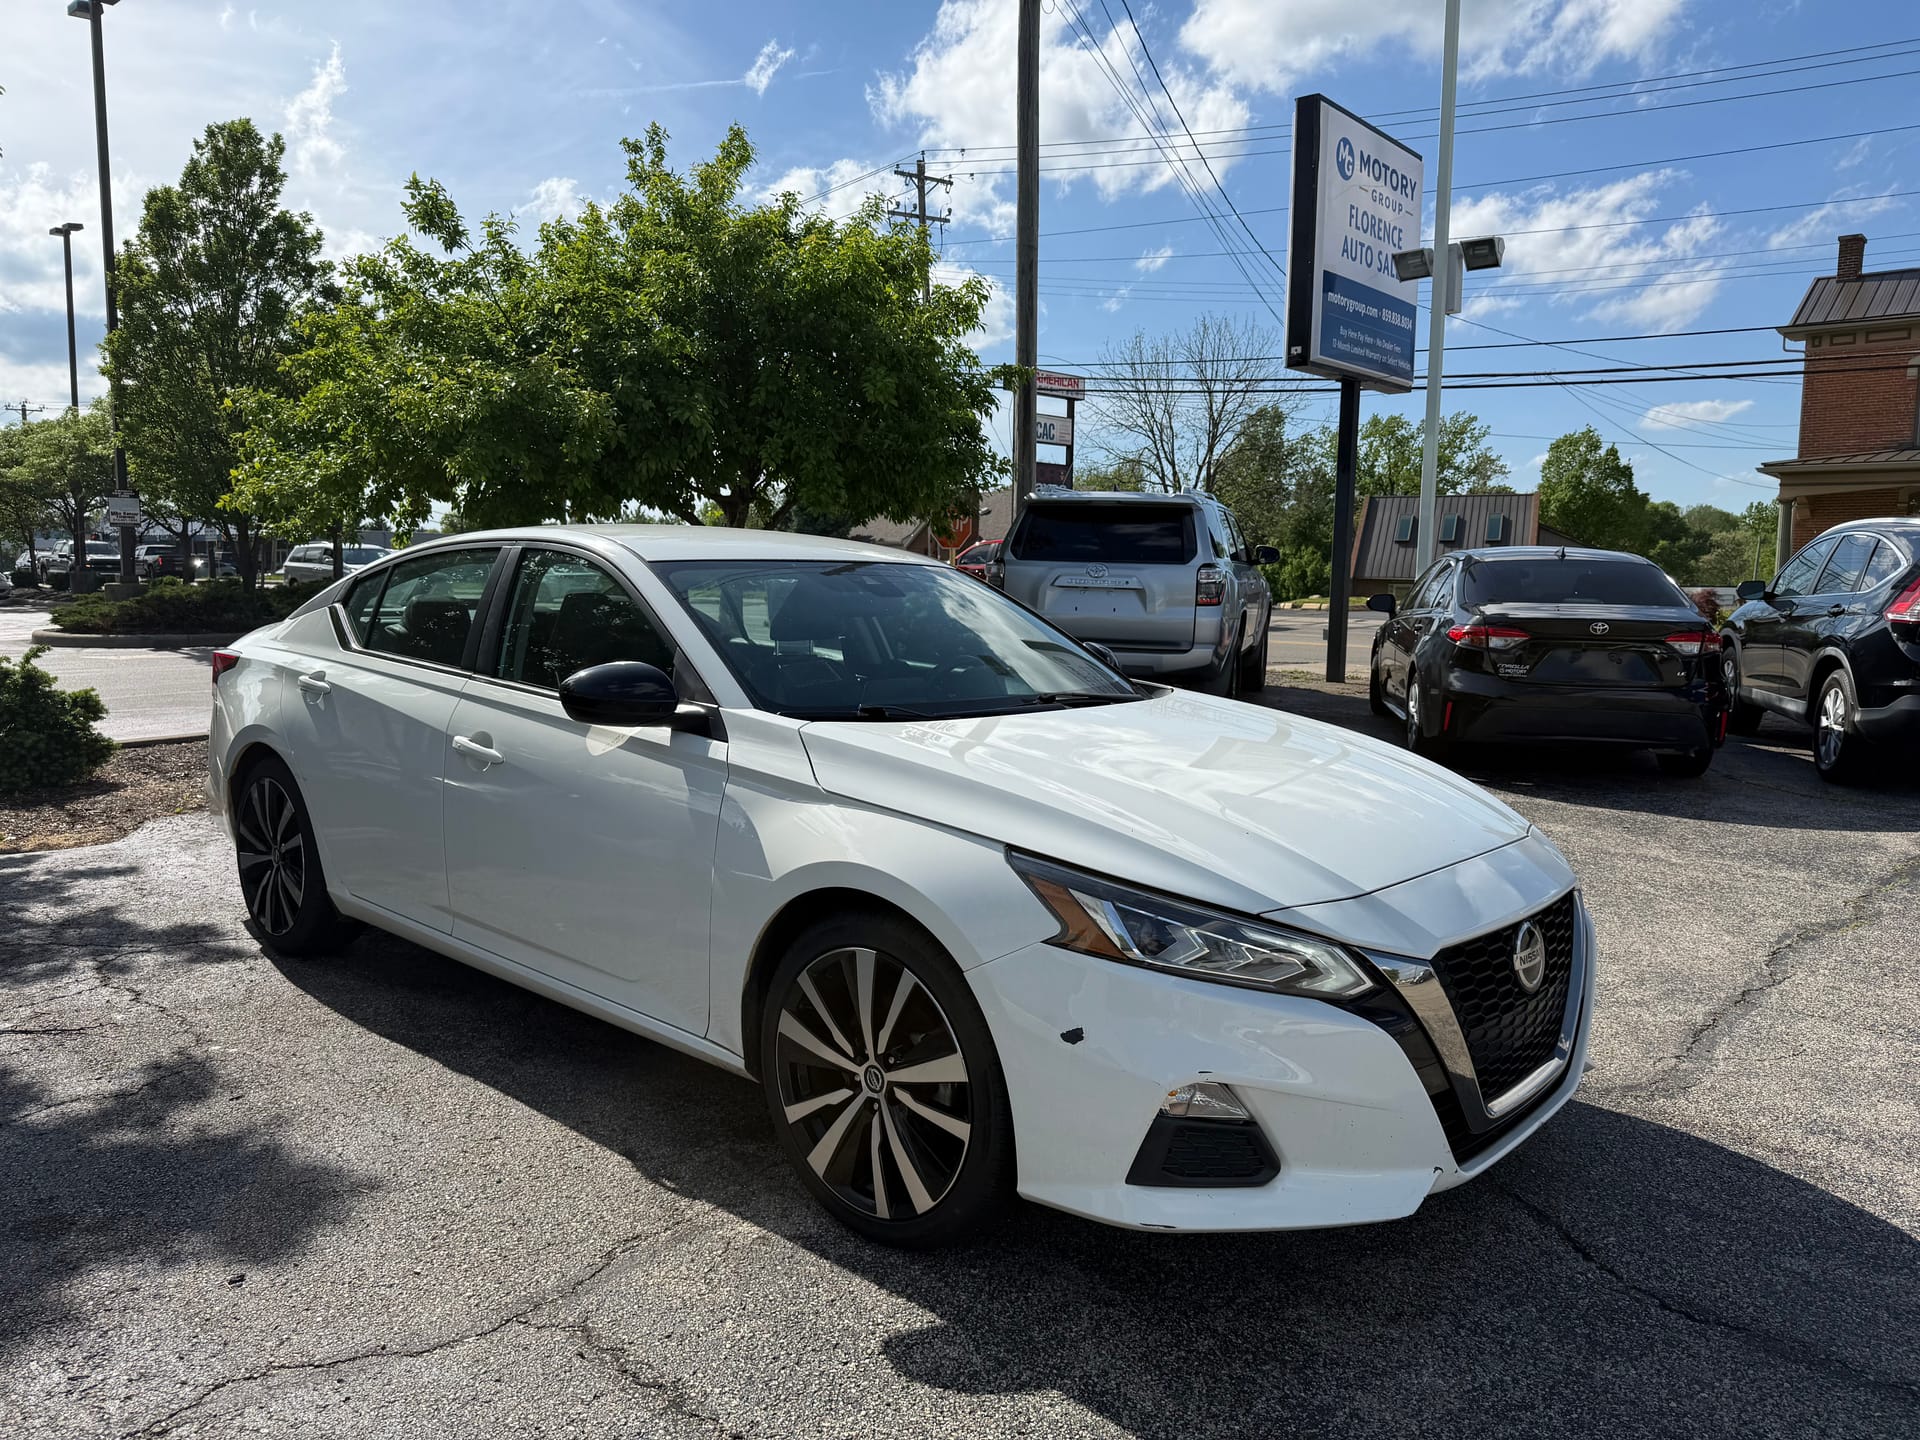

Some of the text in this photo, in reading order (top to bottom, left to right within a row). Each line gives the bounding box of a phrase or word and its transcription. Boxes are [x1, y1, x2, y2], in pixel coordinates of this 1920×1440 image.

[1360, 149, 1417, 201] MOTORY
[1371, 189, 1404, 215] GROUP
[1349, 204, 1403, 250] FLORENCE
[1341, 235, 1399, 280] AUTO SAL
[1328, 292, 1378, 317] motorygroup.com
